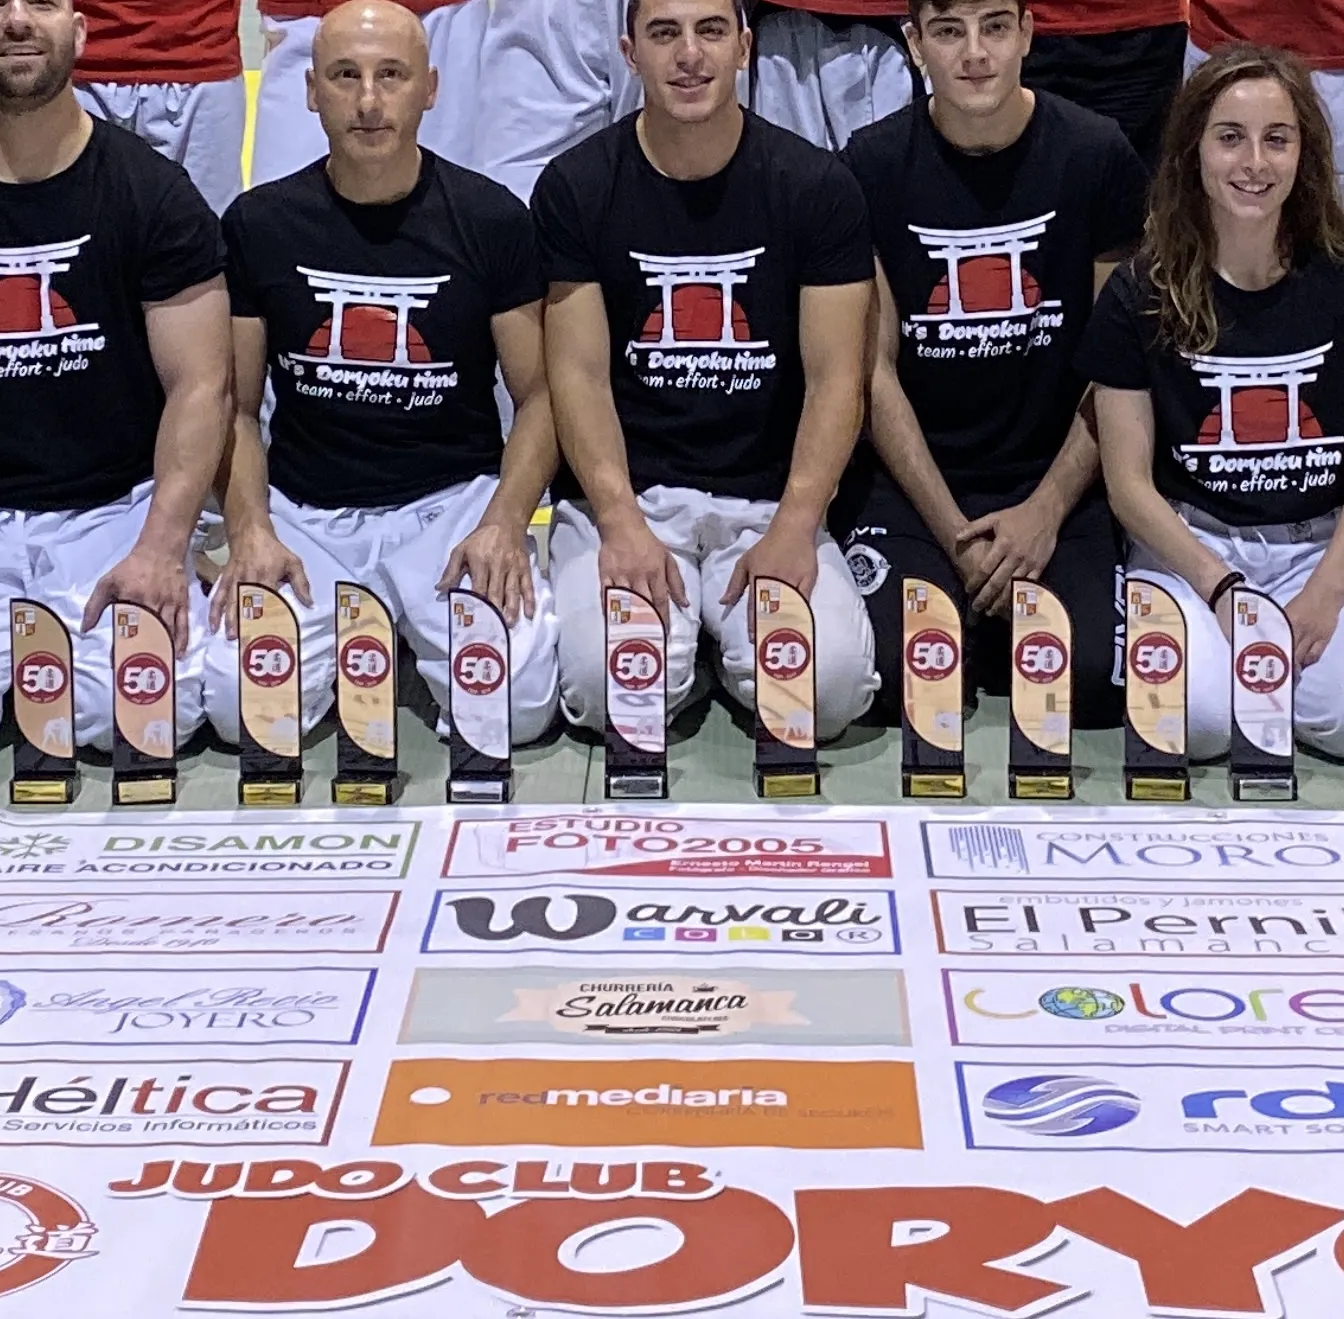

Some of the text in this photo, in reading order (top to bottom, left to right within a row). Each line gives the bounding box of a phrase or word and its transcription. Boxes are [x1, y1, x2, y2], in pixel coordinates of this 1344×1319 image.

[60, 333, 106, 353] time
[938, 320, 1027, 343] Doryoku
[916, 340, 1012, 358] team effort
[53, 354, 89, 377] judo
[648, 351, 777, 371] Doryoku time
[315, 365, 458, 389] Doryoku time
[675, 371, 761, 395] effort judo
[295, 380, 444, 411] team effort judo
[1209, 452, 1303, 473] Doryoku
[1240, 469, 1336, 493] effort judo
[250, 649, 290, 676] 50
[616, 652, 657, 679] 50
[765, 642, 807, 669] 50
[1136, 646, 1177, 673] 50
[22, 665, 64, 692] 50
[460, 656, 501, 683] 50
[509, 818, 682, 833] ESTUDIO
[1036, 831, 1329, 843] CONSTRUCCIONES
[104, 835, 399, 852] DISAMON
[506, 833, 823, 854] FOTO2005
[1043, 842, 1341, 867] MORO
[77, 860, 391, 872] ACONDICIONADO
[999, 894, 1303, 908] embutidos y jamones
[446, 895, 881, 940] Warvali
[964, 905, 1039, 933] El
[580, 983, 674, 992] CHURRERÍA
[556, 993, 748, 1017] Salamanca
[108, 1009, 317, 1033] JOYERO
[1104, 1024, 1212, 1034] DIGITAL
[1217, 1025, 1306, 1035] PRINT
[479, 1084, 787, 1107] redmediaria
[4, 1117, 132, 1134] Servicios
[143, 1116, 316, 1132] Informáticos
[1184, 1122, 1296, 1136] SMART
[109, 1159, 716, 1198] JUDO CLUB
[15, 1221, 100, 1260] 道
